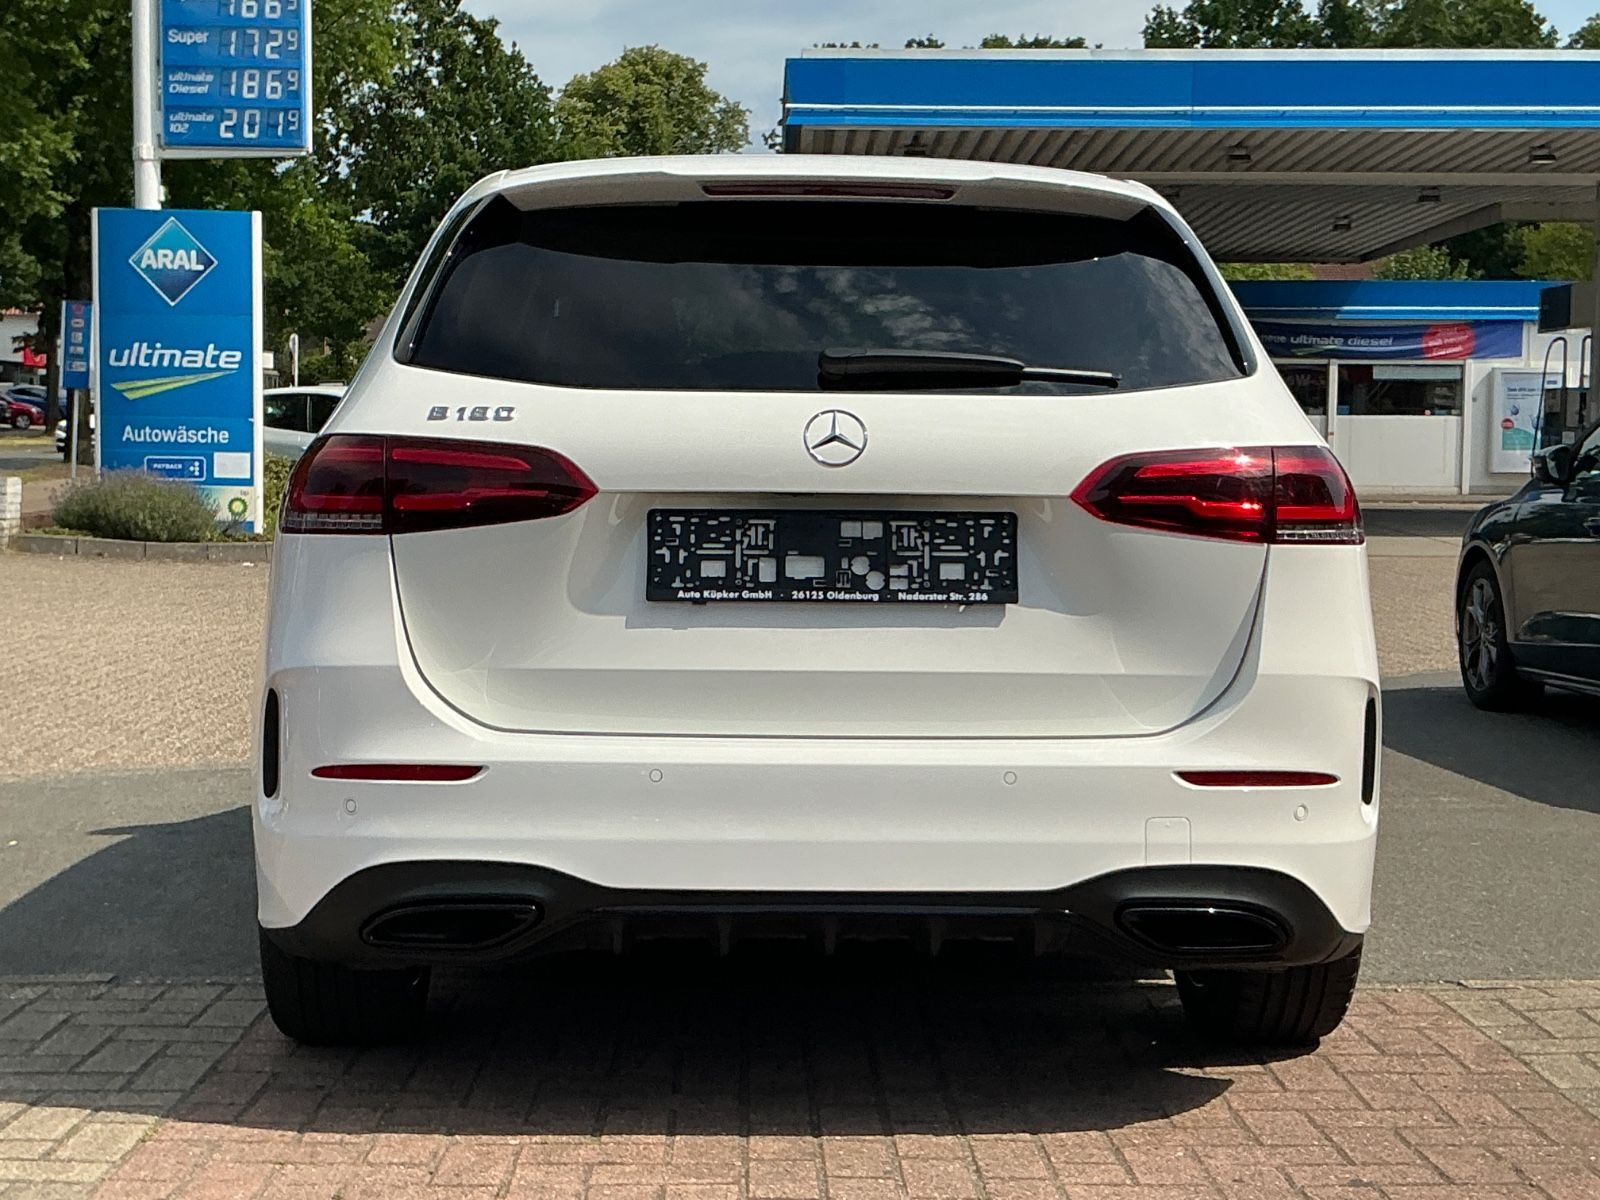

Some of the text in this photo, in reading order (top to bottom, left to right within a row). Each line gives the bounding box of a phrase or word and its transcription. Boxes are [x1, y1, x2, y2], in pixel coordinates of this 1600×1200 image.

[168, 29, 209, 45] Super
[168, 72, 214, 83] ultimate
[168, 84, 209, 94] Diesel
[169, 112, 215, 123] ultimate
[169, 123, 189, 134] 102
[140, 249, 205, 271] ARAL
[1290, 335, 1344, 346] ultimate
[1347, 336, 1394, 346] diesel
[108, 342, 242, 368] ultimate
[426, 406, 450, 421] B
[122, 424, 229, 444] Autowäsche
[677, 590, 701, 599] Auto
[703, 589, 739, 600] Küpker
[741, 590, 773, 600] GmbH
[791, 590, 824, 600] 26125
[826, 590, 879, 602] Oldenburg
[949, 592, 967, 601] Str.
[968, 591, 989, 601] 286
